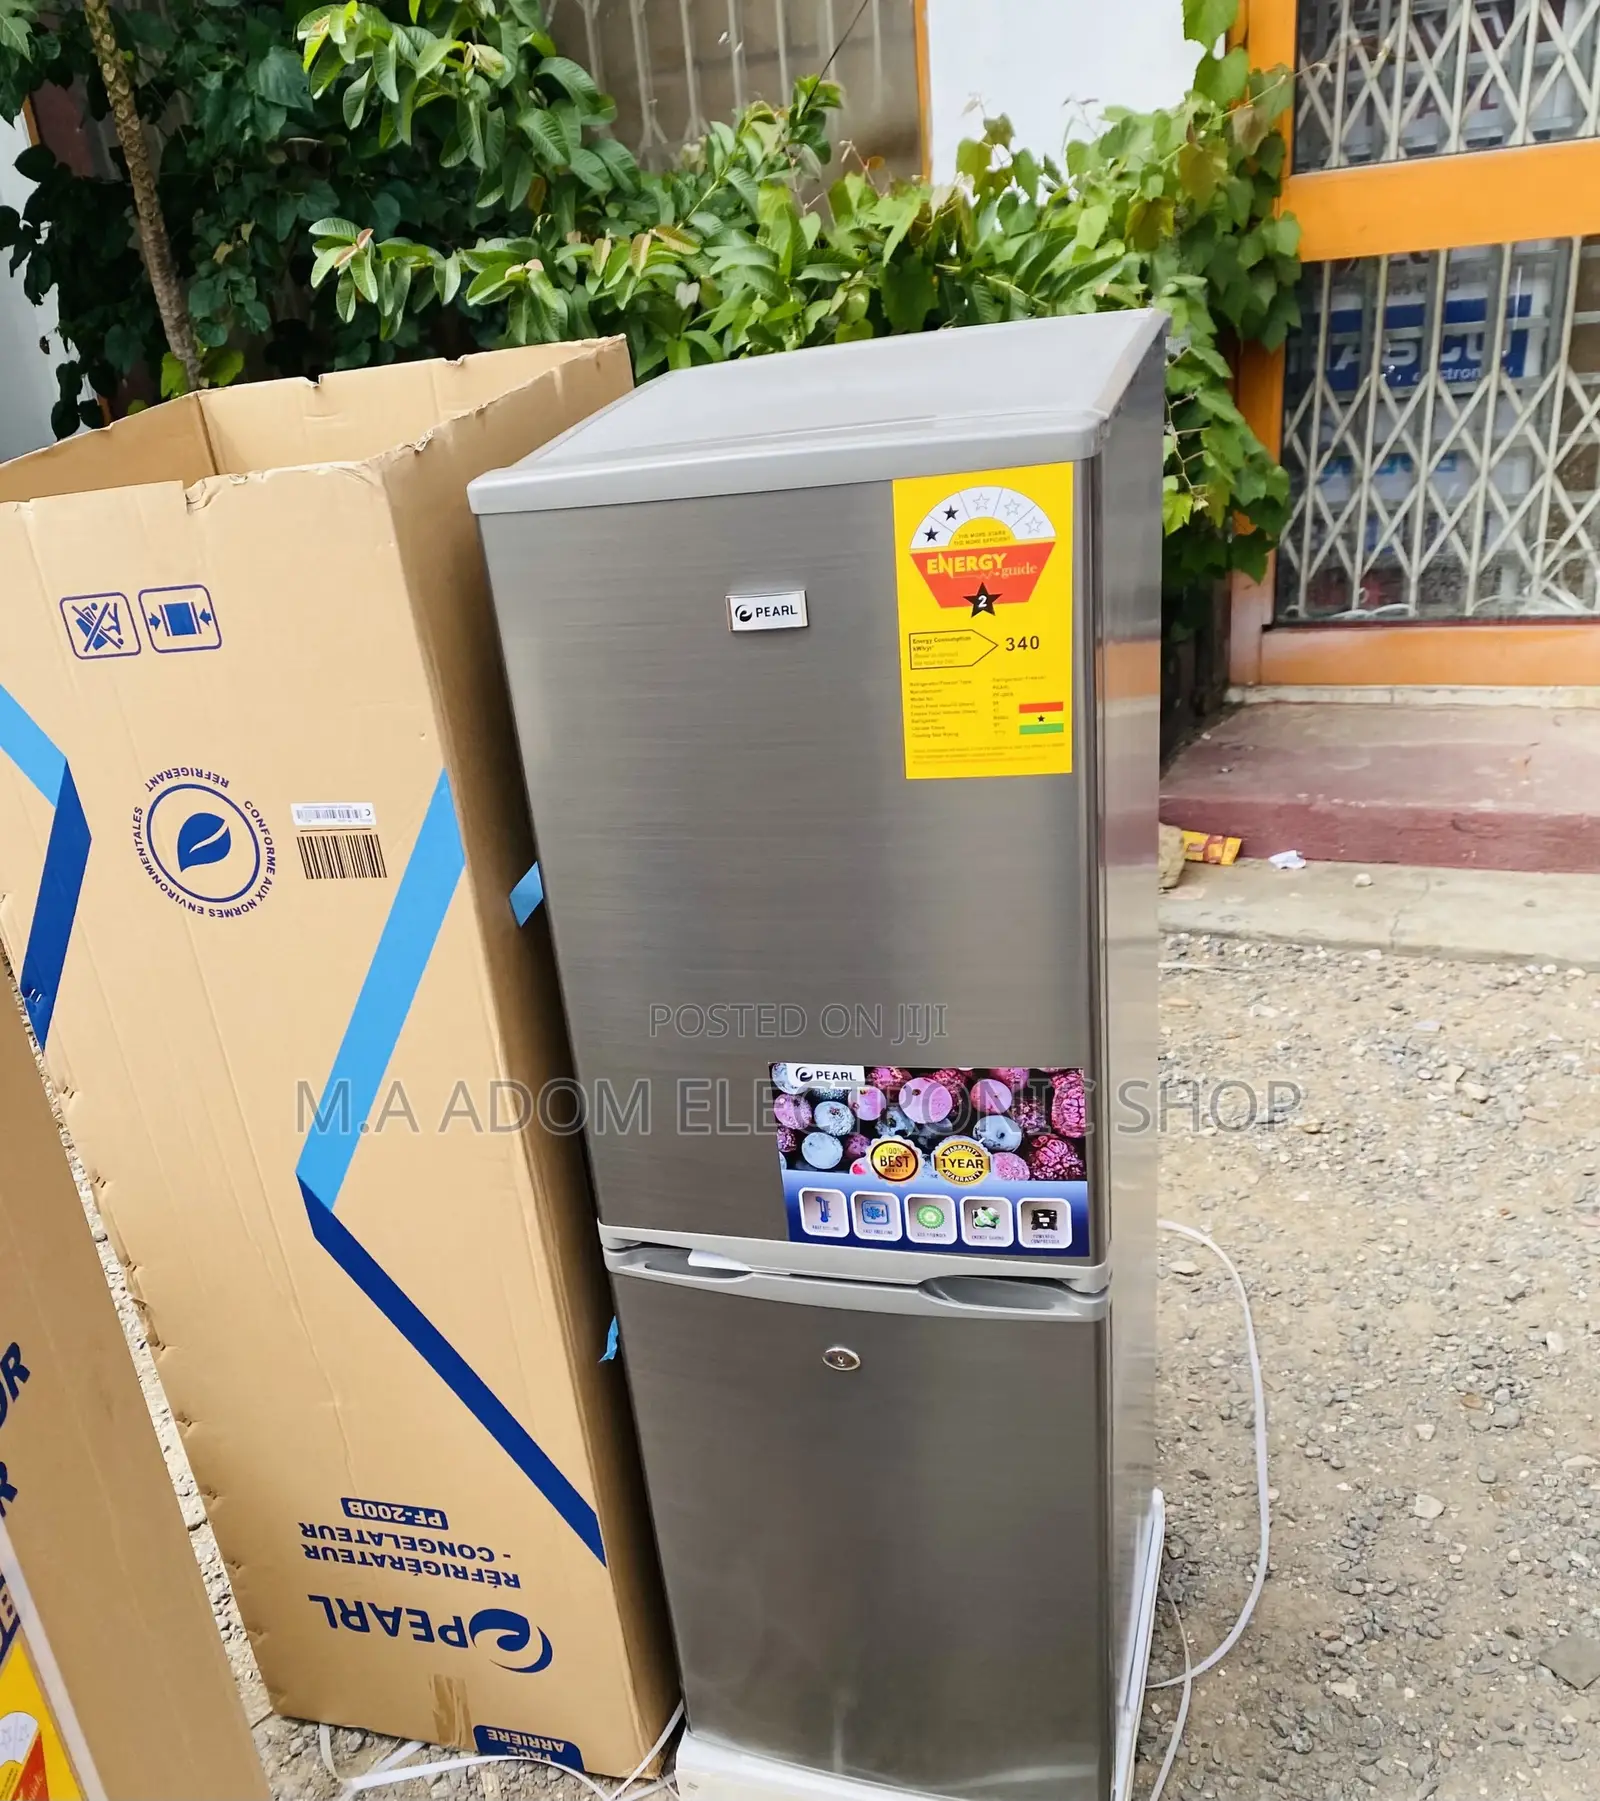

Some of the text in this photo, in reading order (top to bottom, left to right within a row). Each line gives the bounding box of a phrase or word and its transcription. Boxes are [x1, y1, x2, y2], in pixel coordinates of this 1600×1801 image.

[926, 552, 1038, 580] ENERGY guide
[755, 604, 799, 618] PEARL
[978, 595, 988, 608] 2
[1005, 635, 1040, 652] 340
[244, 800, 276, 875] CONFORME
[132, 806, 205, 915] ENVIRONMENTALES
[255, 876, 273, 901] AUX
[208, 899, 258, 918] NORMES
[815, 1070, 857, 1082] PEARL
[943, 1145, 981, 1156] WARRANTY
[879, 1155, 910, 1168] BEST
[940, 1158, 984, 1169] 1 YEAR
[945, 1170, 981, 1182] WARRANTY
[347, 1500, 443, 1527] PF-200B
[298, 1522, 496, 1563] CONGELATEUR
[300, 1544, 521, 1589] RÉFRIGÉRATEUR
[307, 1594, 469, 1649] PEARL
